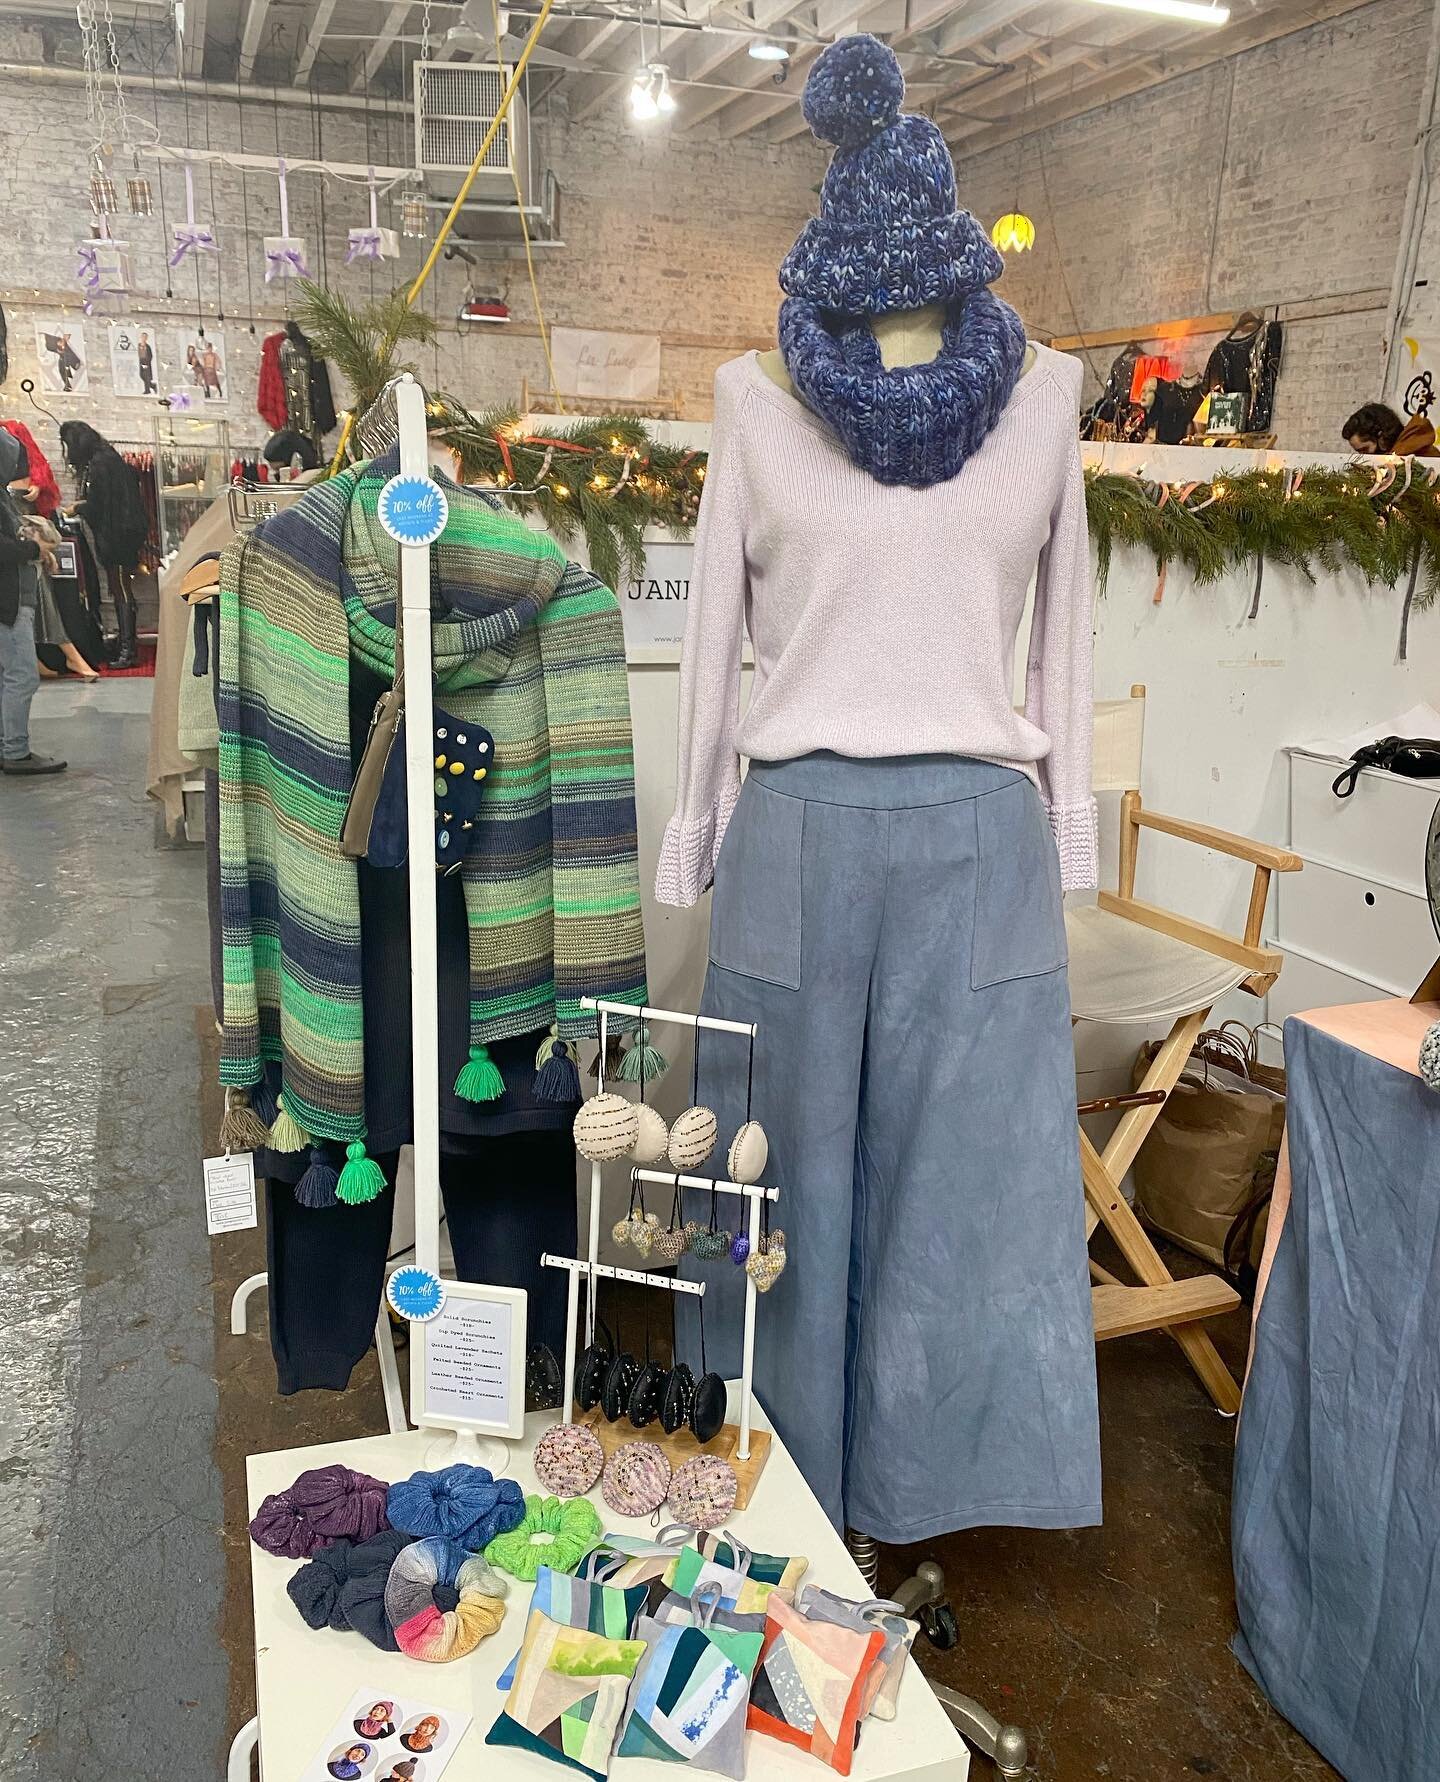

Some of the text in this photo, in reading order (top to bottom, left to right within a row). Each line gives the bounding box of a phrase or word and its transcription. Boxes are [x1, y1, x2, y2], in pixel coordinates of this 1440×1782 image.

[392, 494, 435, 514] 10% off
[398, 1281, 434, 1297] 10% off
[461, 1315, 492, 1325] Scrunchies
[465, 1332, 496, 1340] Scrunchies
[473, 1362, 502, 1370] Ornaments
[475, 1377, 503, 1385] Ornaments
[476, 1391, 504, 1400] Ornaments
